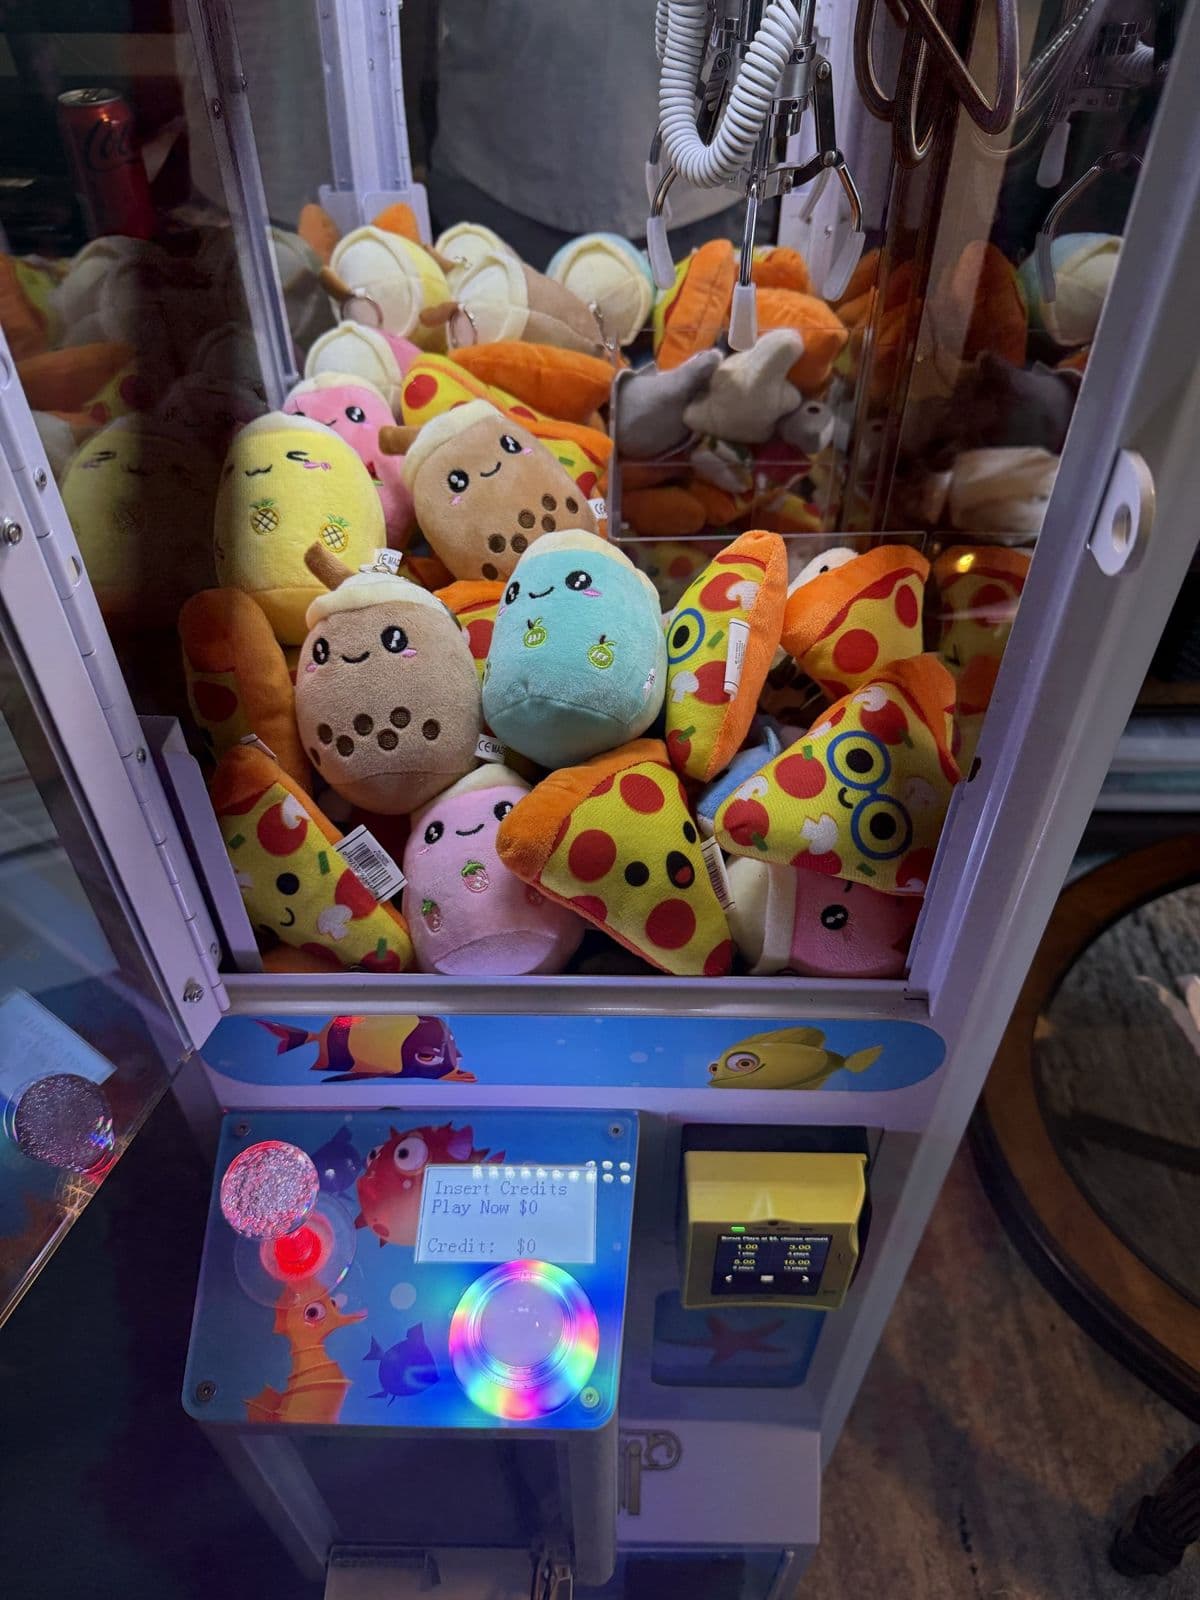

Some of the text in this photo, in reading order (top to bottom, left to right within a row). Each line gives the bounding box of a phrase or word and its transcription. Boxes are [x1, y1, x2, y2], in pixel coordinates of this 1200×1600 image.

[479, 740, 491, 753] CE
[435, 1179, 568, 1196] Insert Credits
[432, 1200, 538, 1216] Play Now $0
[427, 1238, 536, 1255] Credit: $0
